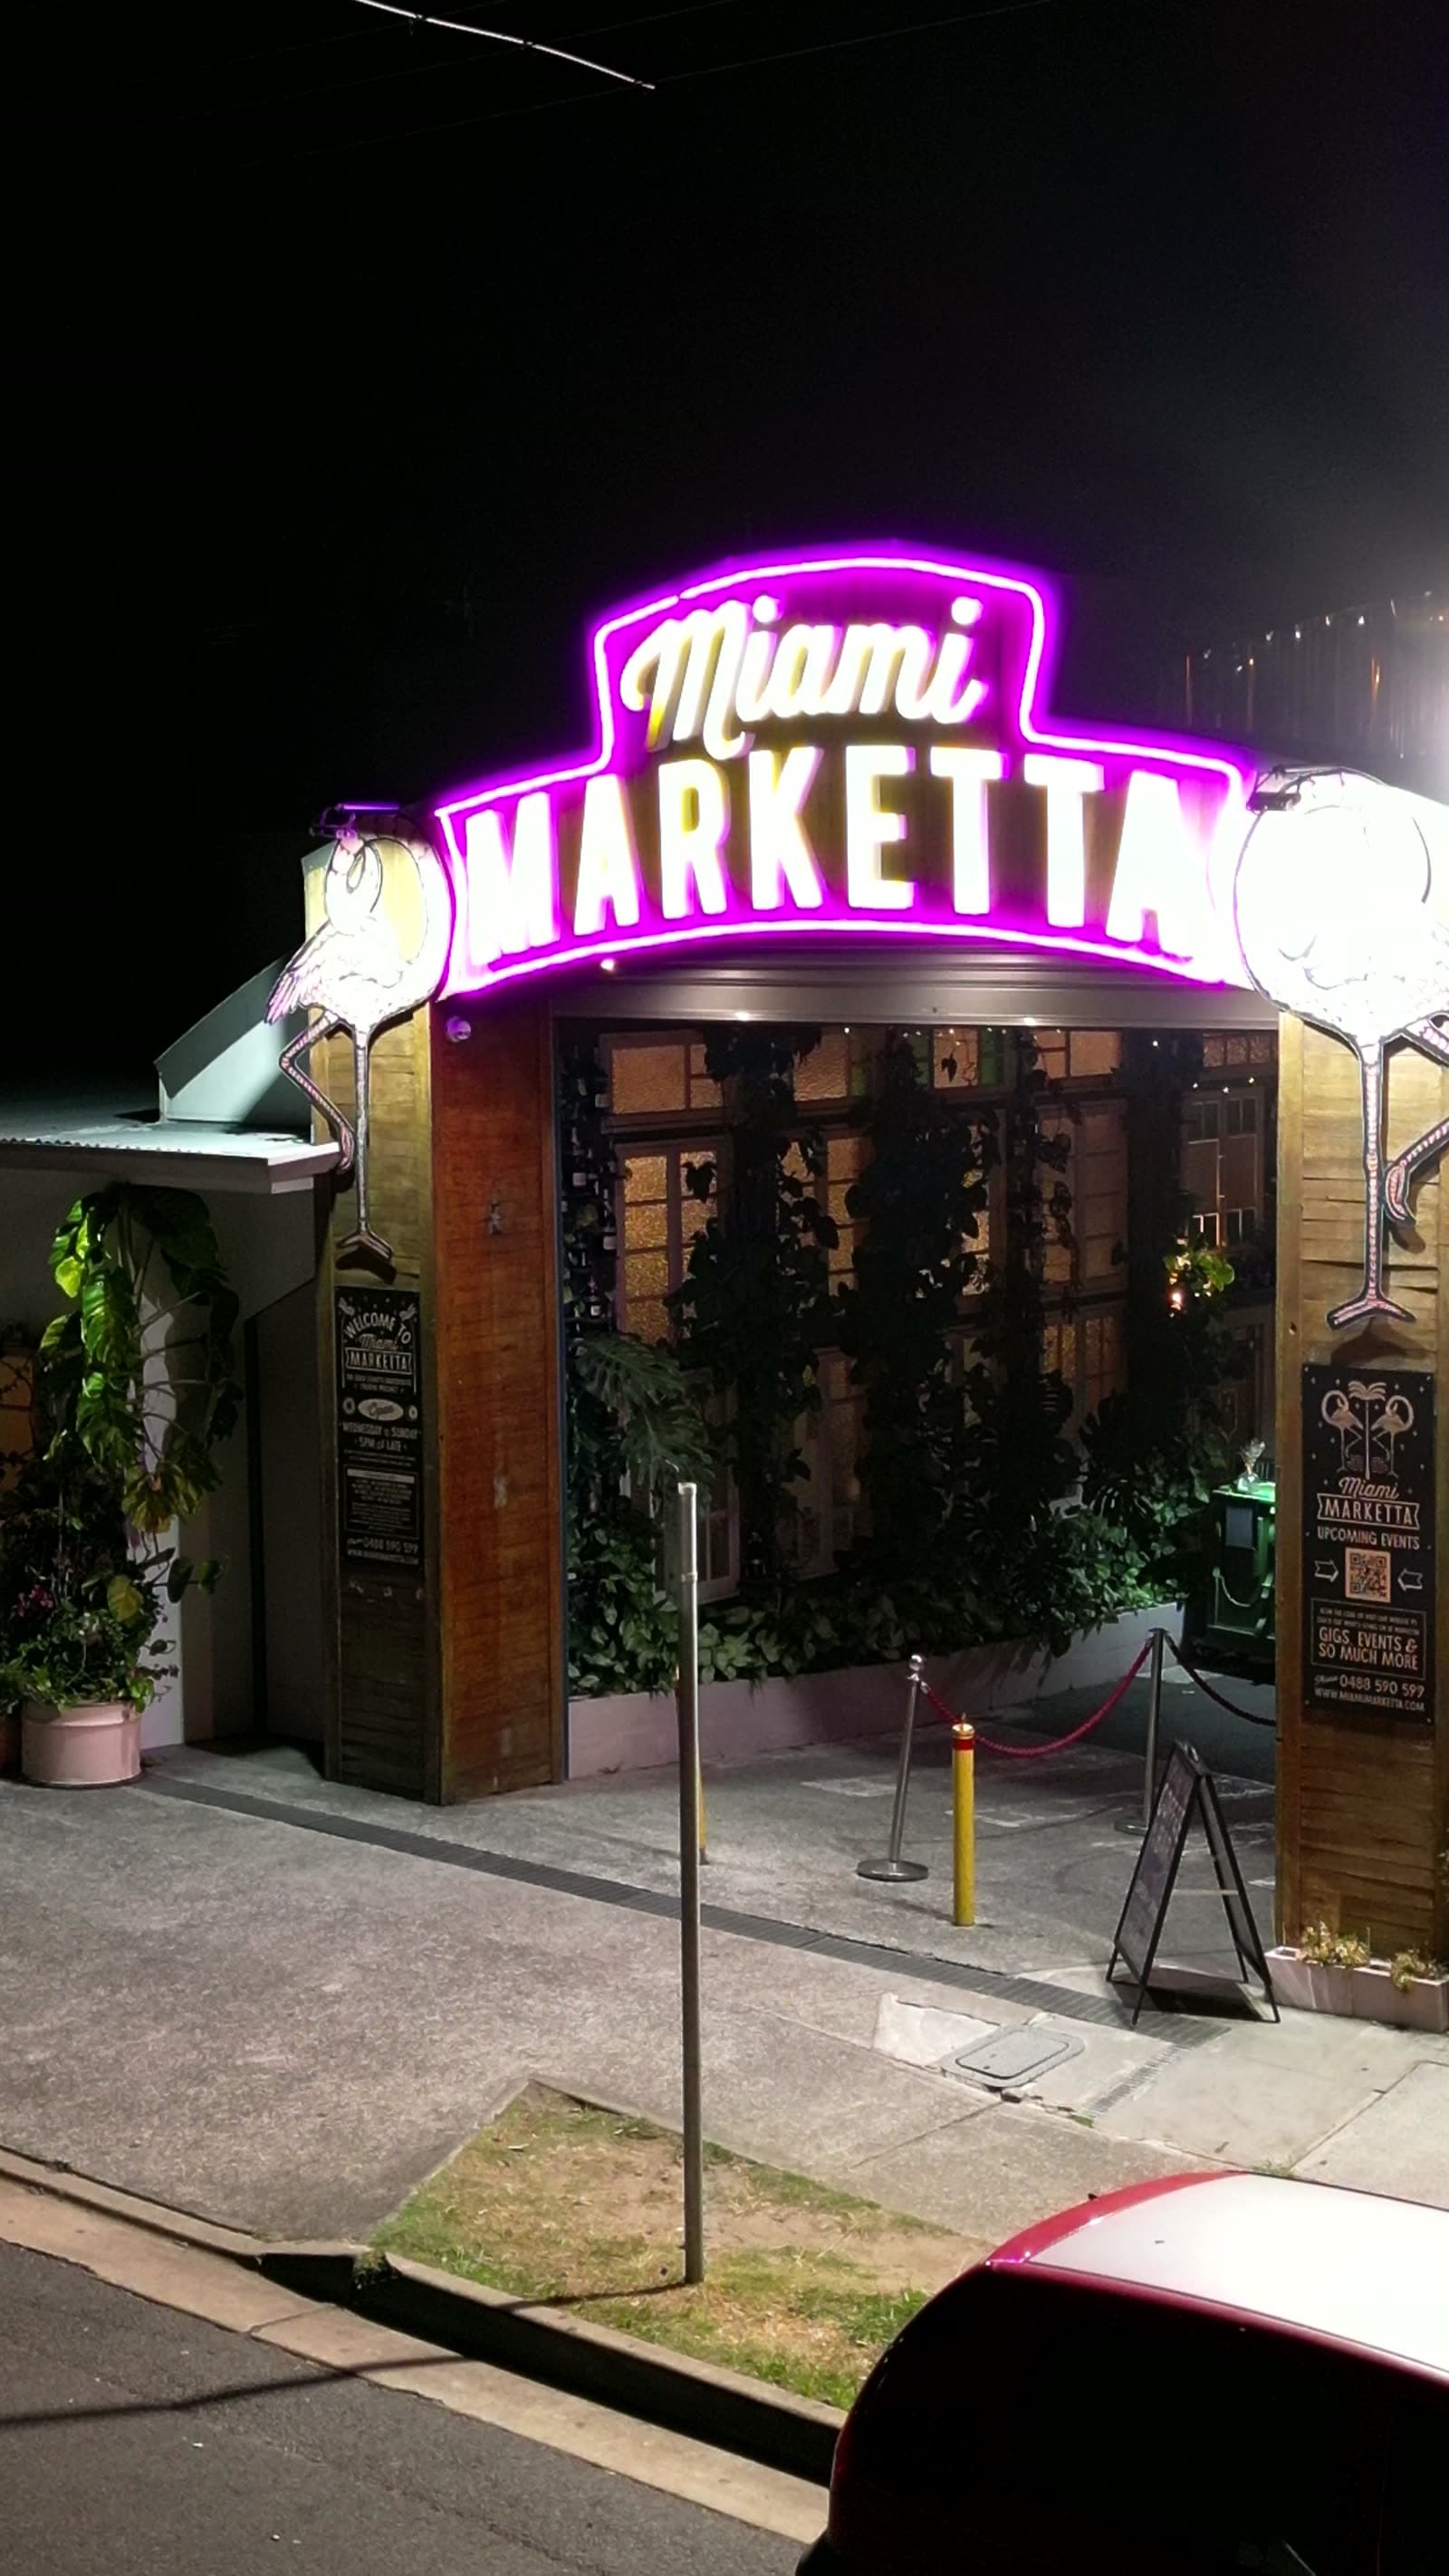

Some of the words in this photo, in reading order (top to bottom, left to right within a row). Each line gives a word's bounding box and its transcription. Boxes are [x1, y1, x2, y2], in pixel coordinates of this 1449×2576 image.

[620, 595, 985, 759] Miami
[465, 745, 1200, 966] MARKETTA
[344, 1312, 396, 1339] WELCOME
[398, 1323, 411, 1344] TO
[350, 1350, 408, 1370] MARKETTA
[1339, 1476, 1399, 1500] Miami
[1324, 1497, 1413, 1525] MARKETTA
[1318, 1526, 1377, 1545] UPCOMING
[1381, 1533, 1420, 1550] EVENTS
[1358, 1631, 1402, 1652] EVENTS
[1406, 1638, 1418, 1653] &
[1319, 1643, 1336, 1658] SO
[1339, 1645, 1377, 1665] MUCH
[1381, 1651, 1419, 1670] MORE
[1339, 1674, 1370, 1690] 0488
[1375, 1679, 1398, 1695] 590
